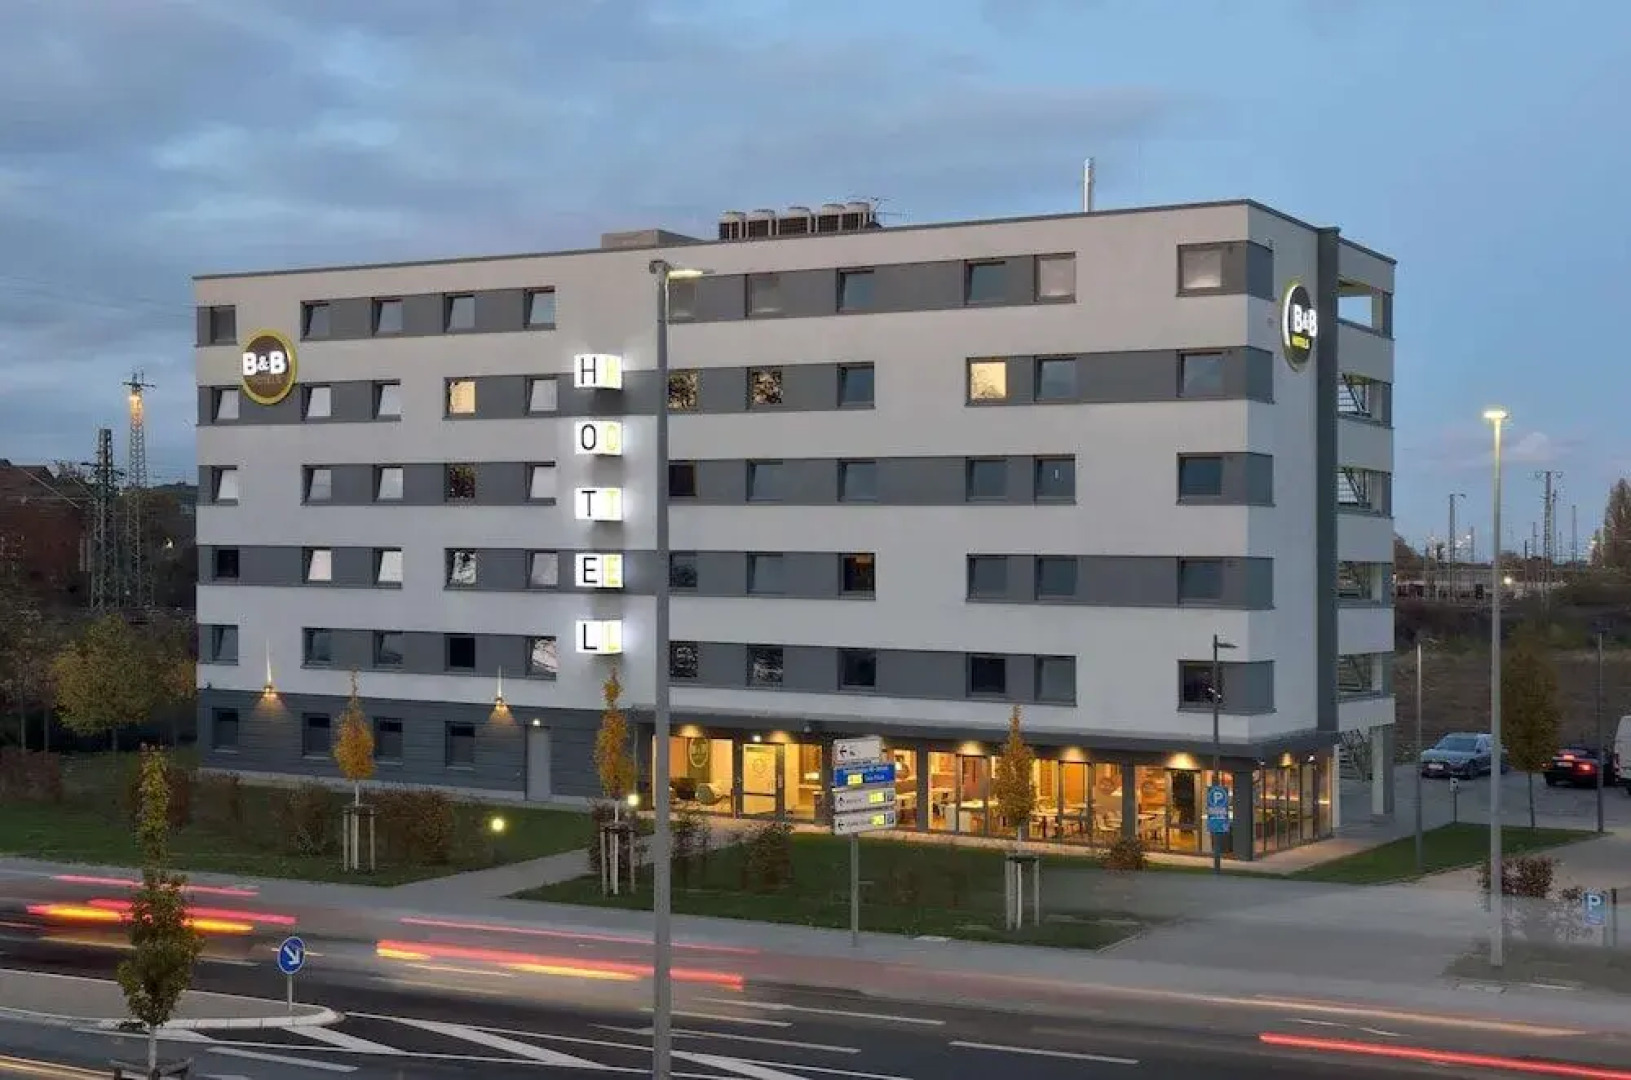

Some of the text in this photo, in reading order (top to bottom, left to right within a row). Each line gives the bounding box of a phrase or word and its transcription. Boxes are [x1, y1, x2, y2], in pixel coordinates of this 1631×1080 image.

[243, 351, 285, 375] B&B
[580, 356, 598, 651] HOTEL
[1588, 895, 1601, 911] P
